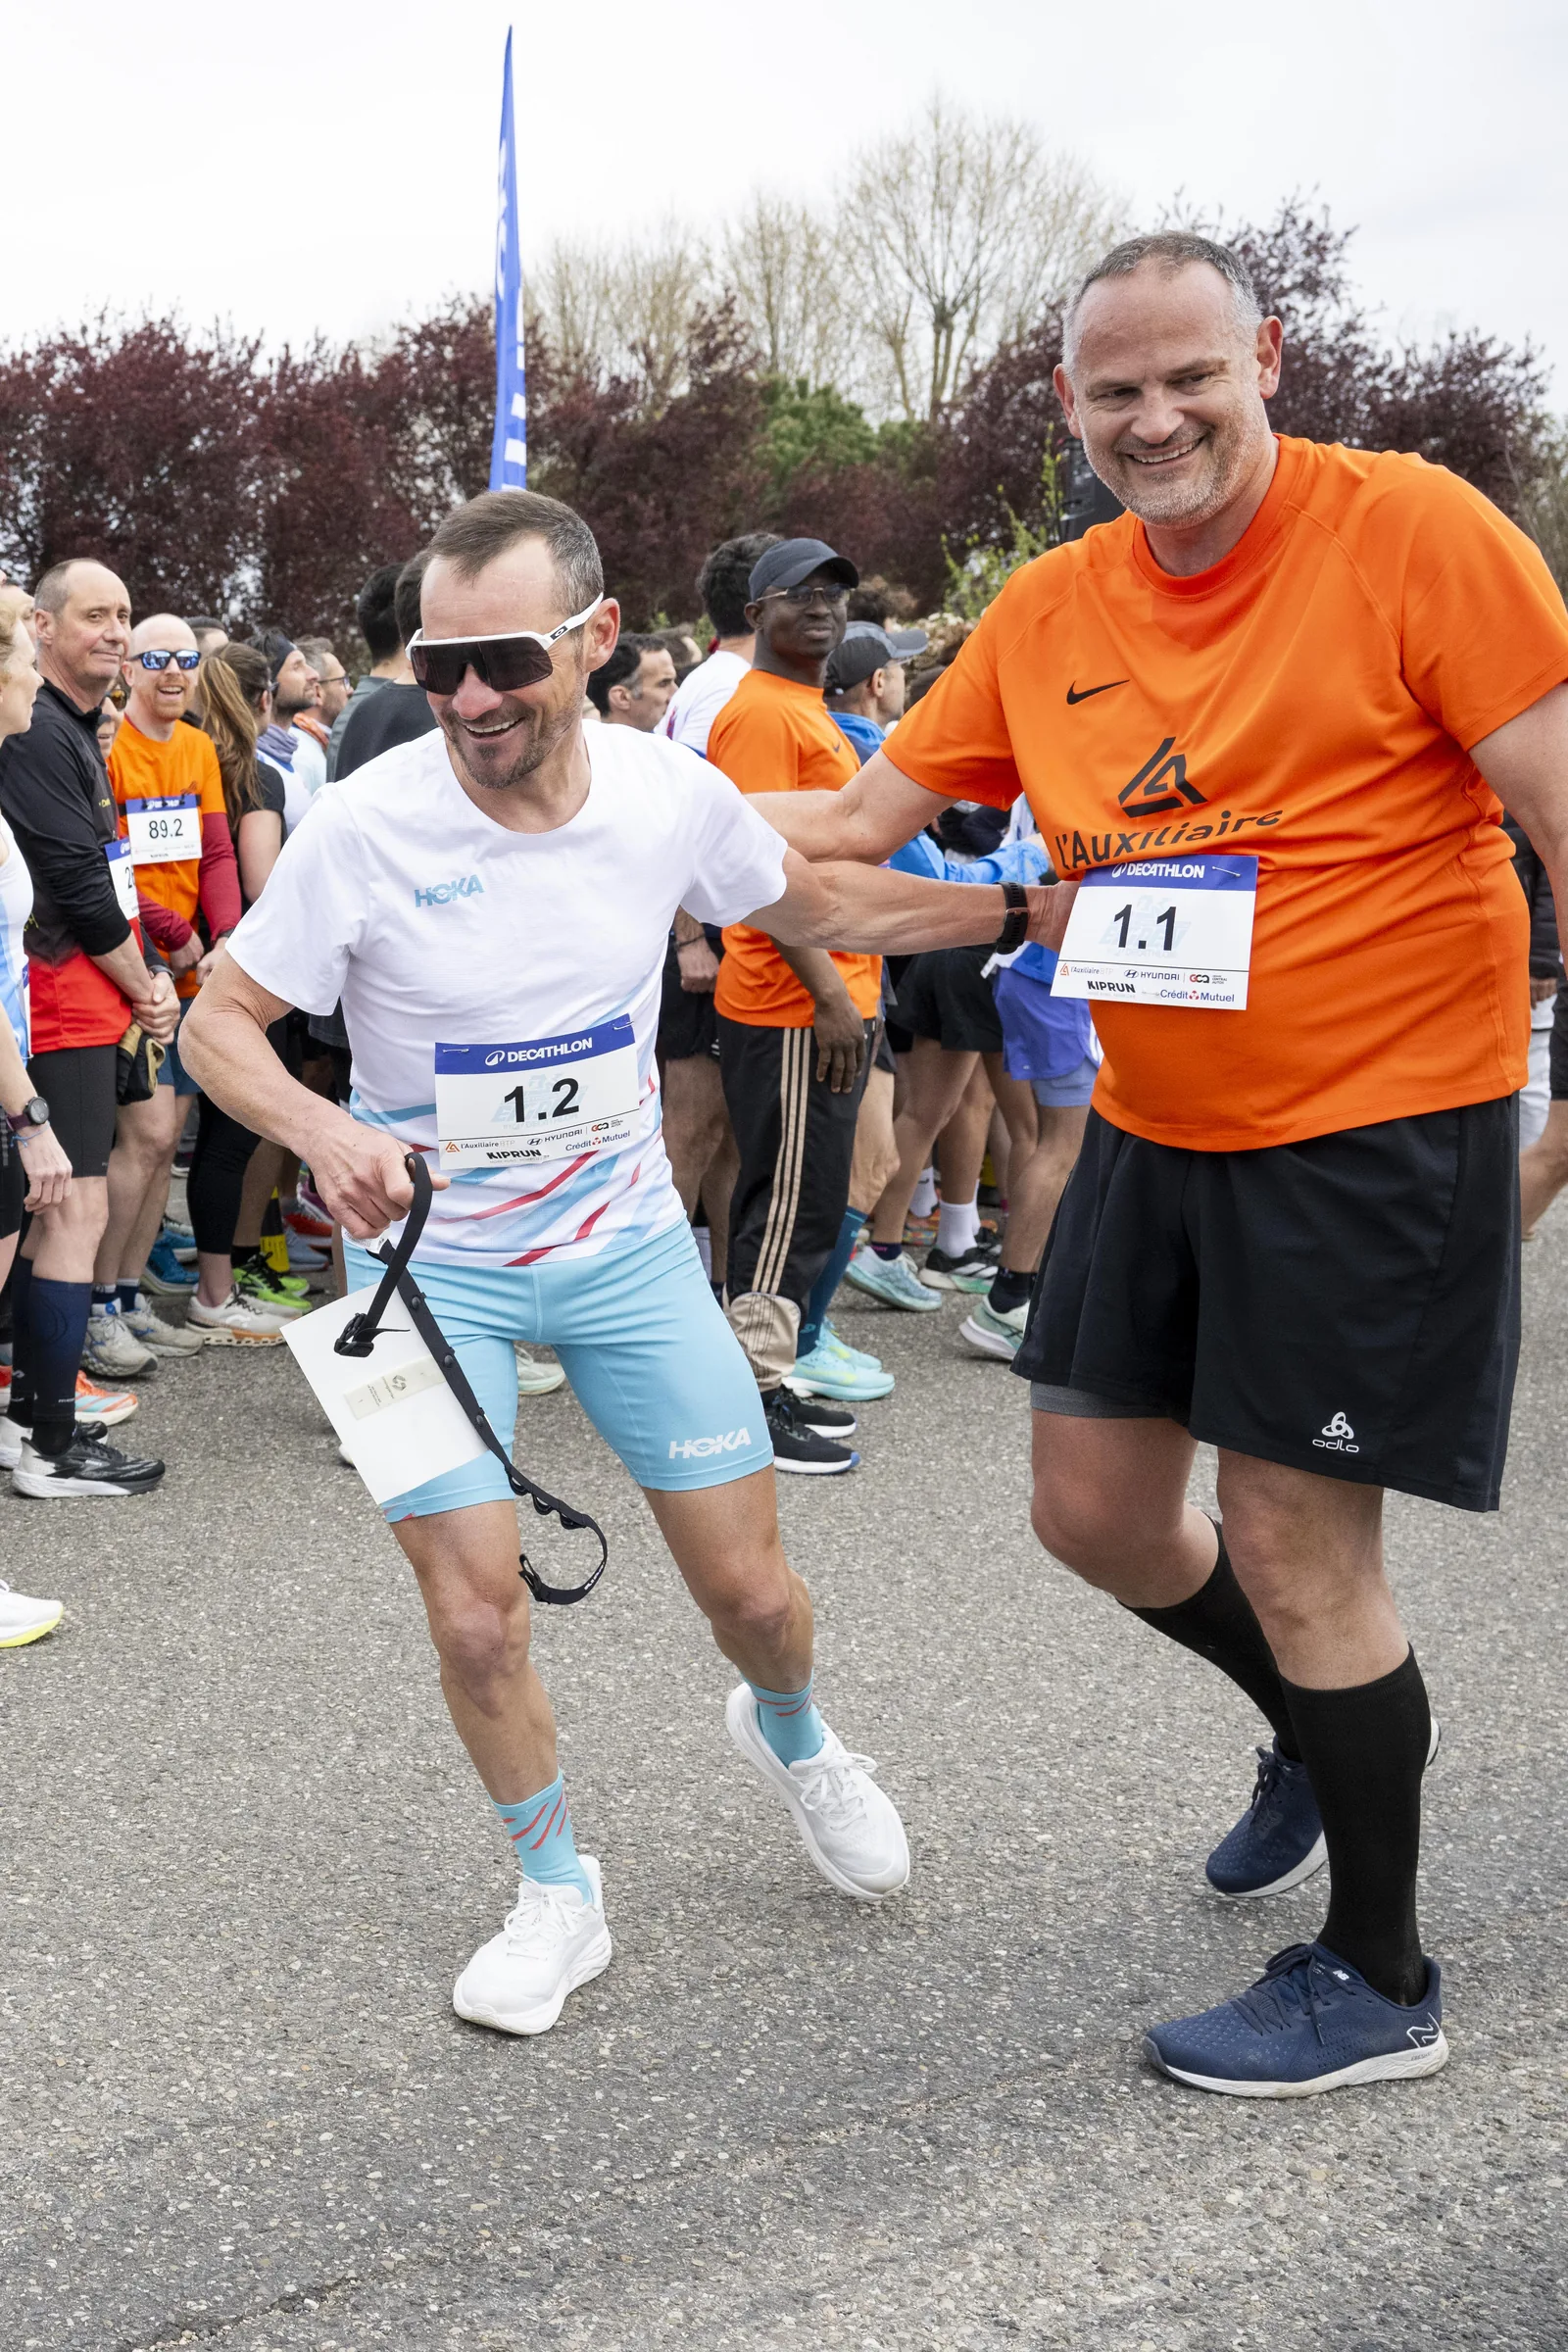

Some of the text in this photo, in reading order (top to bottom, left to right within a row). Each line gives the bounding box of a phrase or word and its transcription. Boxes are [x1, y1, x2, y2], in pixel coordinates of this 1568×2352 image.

[149, 818, 183, 839] 89.2
[1126, 861, 1205, 879] DECATHLON
[414, 874, 486, 907] HOKA
[1113, 904, 1177, 952] 1.1
[1140, 971, 1180, 981] HYUNDAI
[1087, 980, 1136, 994] KIPRUN
[1159, 989, 1235, 1003] Crédit Mutuel
[507, 1037, 593, 1063] DECATHLON
[504, 1077, 580, 1123] 1.2
[544, 1129, 583, 1143] HYUNDAI
[564, 1130, 631, 1152] Crédit Mutuel
[461, 1141, 500, 1150] l'Auxiliaire
[486, 1150, 542, 1159] KIPRUN
[668, 1426, 753, 1459] HOKA
[1312, 1439, 1359, 1452] odlo
